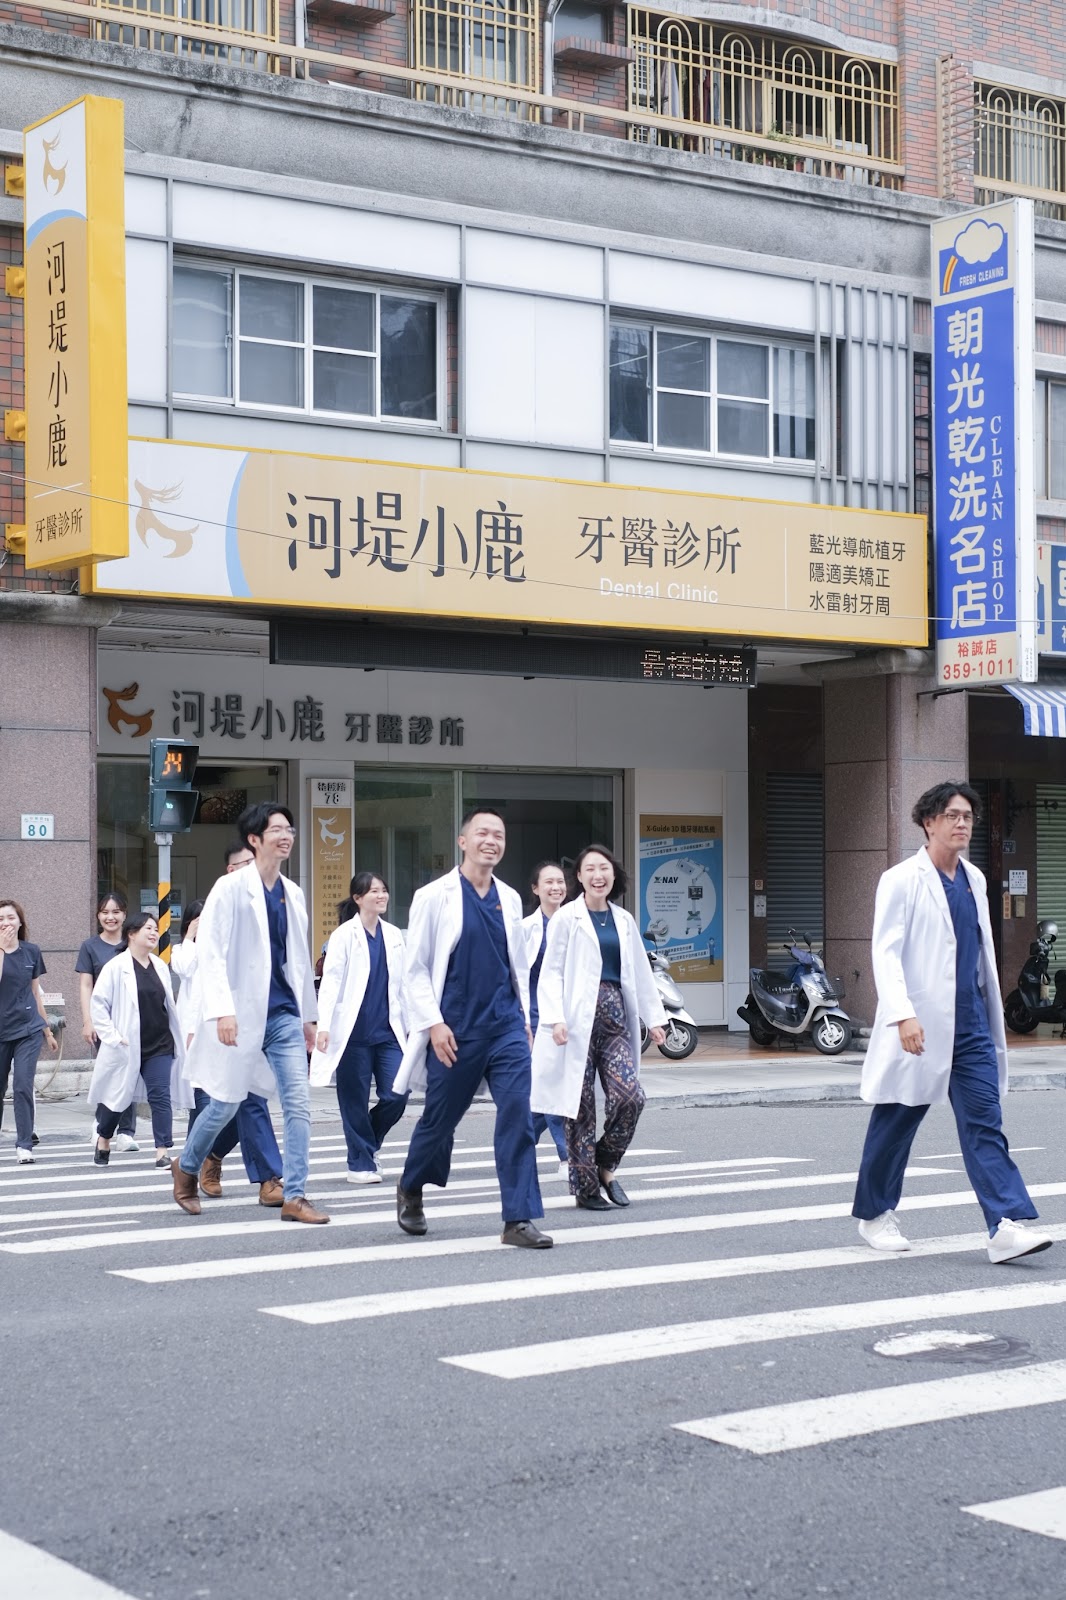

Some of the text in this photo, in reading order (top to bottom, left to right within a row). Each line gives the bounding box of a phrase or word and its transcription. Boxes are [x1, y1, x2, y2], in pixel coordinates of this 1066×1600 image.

[959, 266, 1004, 287] FRESH CLEANING
[46, 240, 68, 469] 河堤小鹿
[947, 306, 986, 630] 朝光乾洗名店
[35, 507, 83, 544] 牙醫診所
[991, 414, 1004, 622] CLEAN SHOP
[286, 491, 742, 583] 河堤小鹿 牙醫診所
[809, 533, 906, 563] 藍光導航植牙
[809, 561, 890, 589] 隱適美矯正
[600, 577, 719, 604] Dental Clinic
[809, 590, 890, 616] 水雷射牙周
[957, 638, 998, 658] 裕誠店
[943, 658, 1014, 681] 359-1011
[172, 689, 466, 747] 河堤小鹿 牙醫診所
[324, 792, 340, 804] 78
[28, 824, 47, 837] 80
[646, 825, 671, 833] X-Guide
[671, 825, 680, 833] 3D
